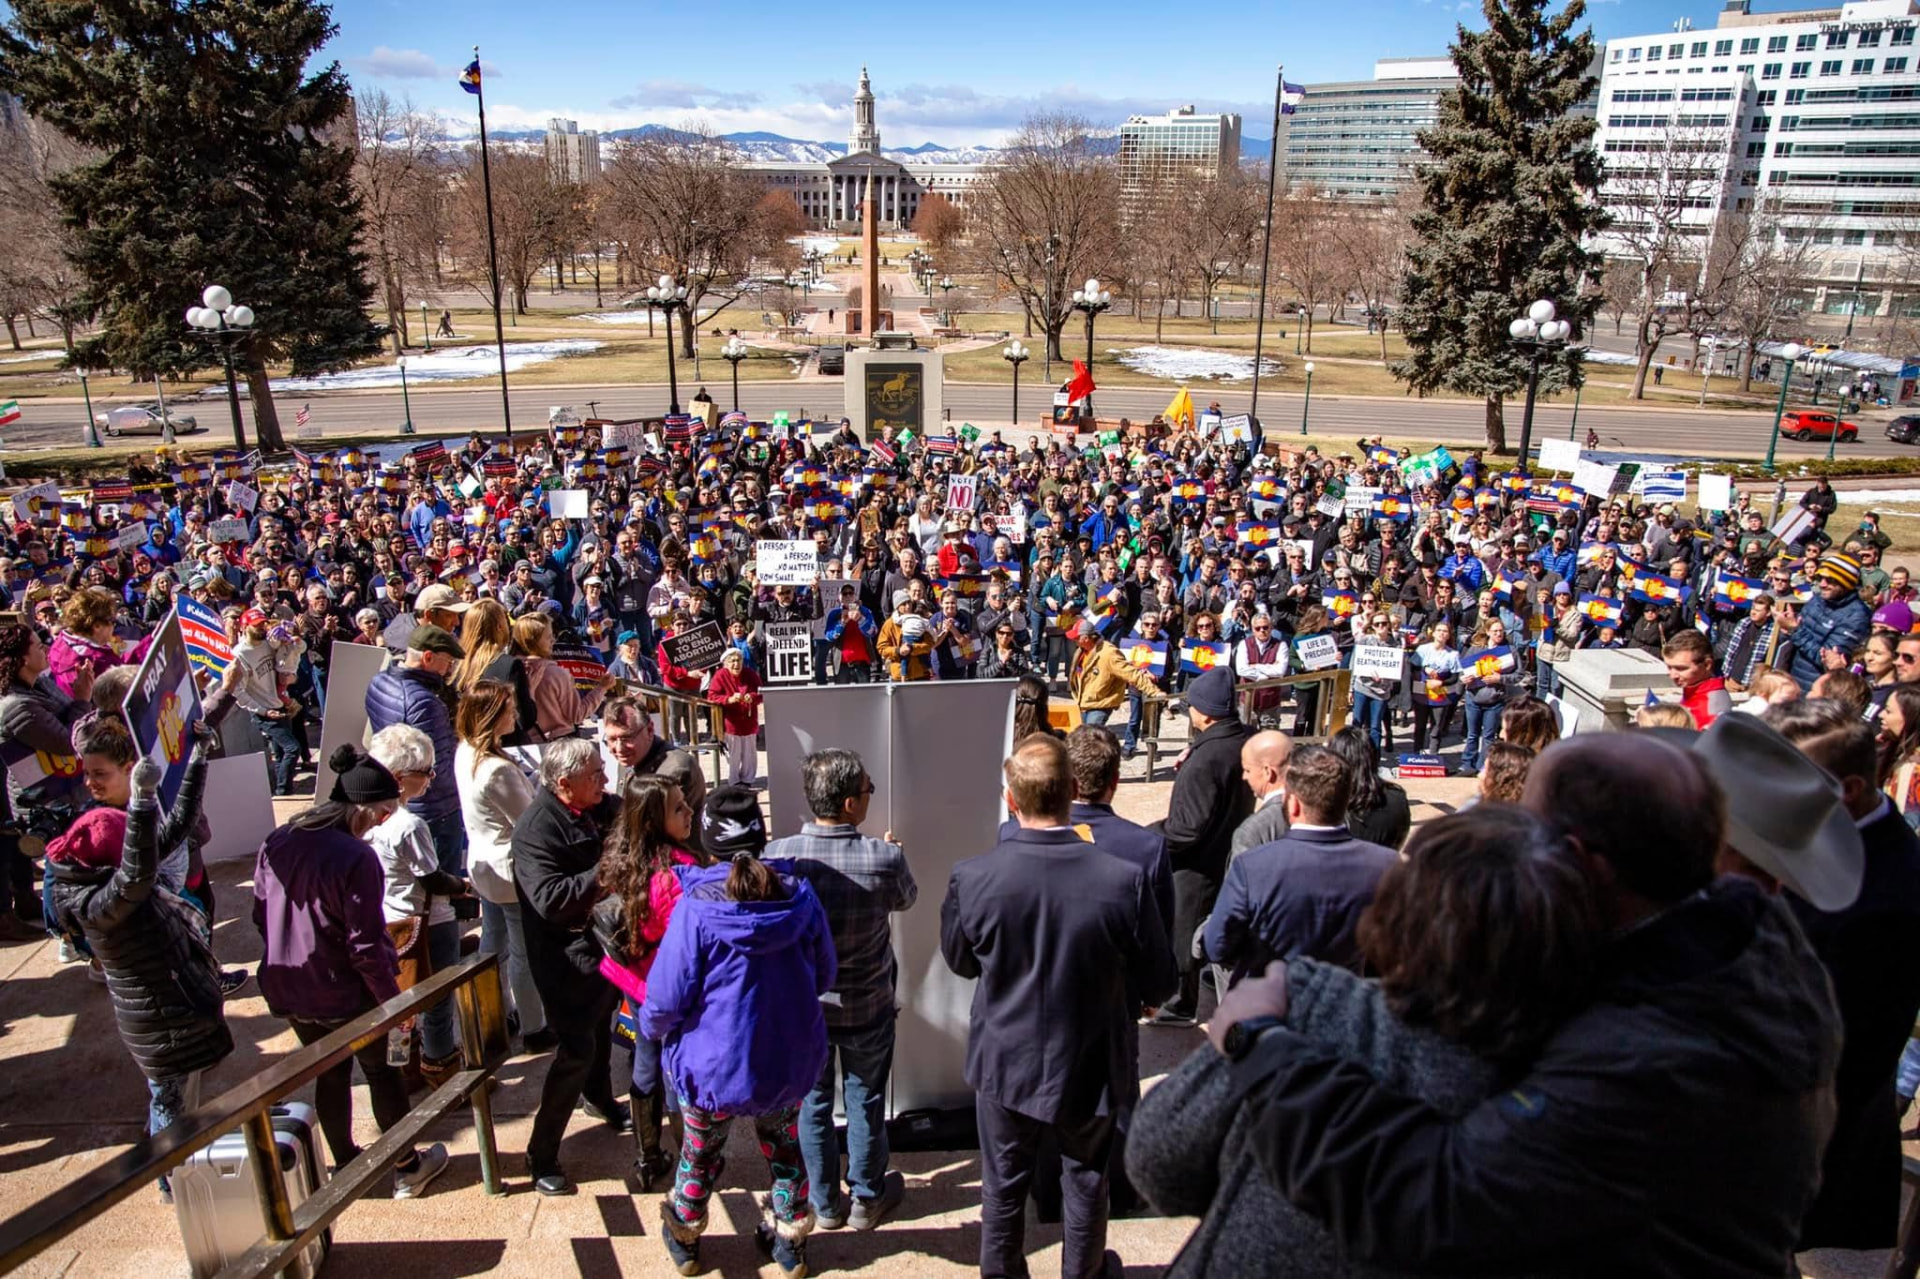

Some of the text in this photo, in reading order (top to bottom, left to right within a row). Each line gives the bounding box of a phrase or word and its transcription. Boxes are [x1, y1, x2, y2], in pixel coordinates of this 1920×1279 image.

[606, 424, 642, 439] JESUS
[949, 485, 973, 509] NO
[996, 516, 1016, 525] SAVE
[789, 552, 813, 560] PERSON
[788, 563, 815, 571] MATTER
[770, 626, 807, 636] REAL MEN
[676, 636, 711, 653] TO END
[677, 631, 702, 645] PRAY
[1306, 638, 1328, 650] LIFE IS
[673, 640, 722, 663] ABORTION
[1304, 647, 1335, 660] PRECIOUS
[1364, 648, 1389, 657] PROTECT
[769, 652, 810, 677] LIFE
[1356, 659, 1400, 668] BEATING HEART
[143, 644, 168, 704] PRAY
